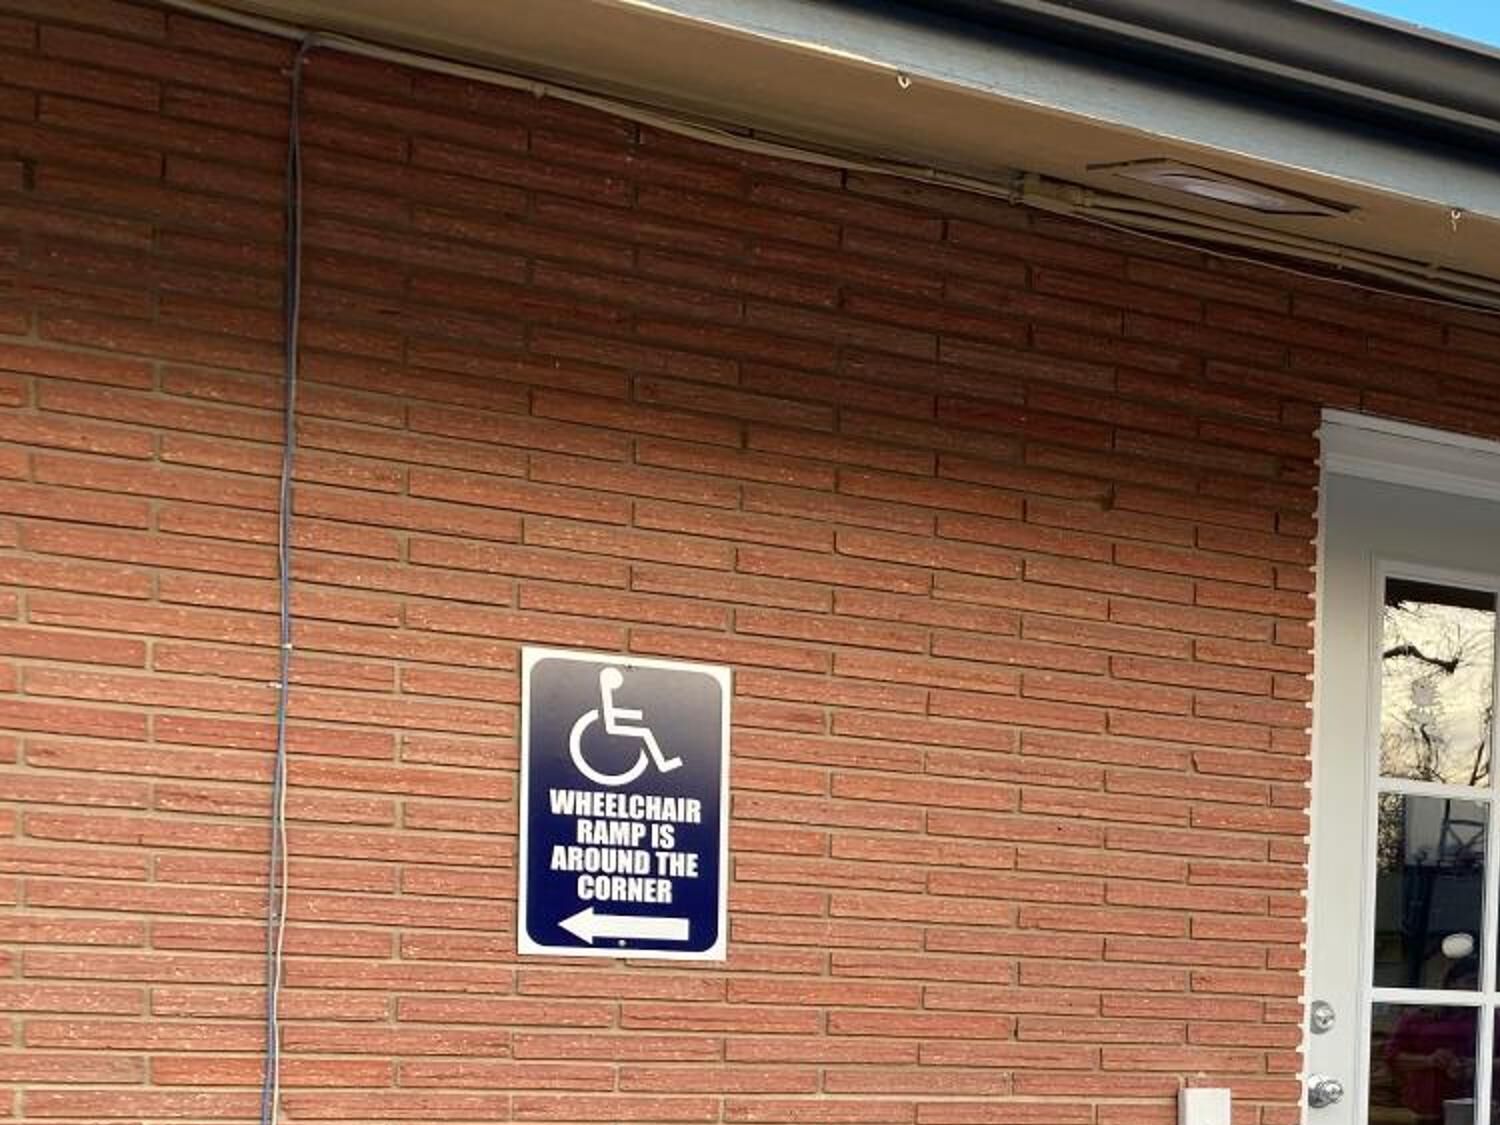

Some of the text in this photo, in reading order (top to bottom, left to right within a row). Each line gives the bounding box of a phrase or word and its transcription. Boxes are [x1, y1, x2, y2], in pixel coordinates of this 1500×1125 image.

[549, 789, 702, 823] WHEELCHAIR
[577, 819, 675, 849] RAMP IS
[550, 846, 698, 877] AROUND THE
[577, 874, 672, 904] CORNER
